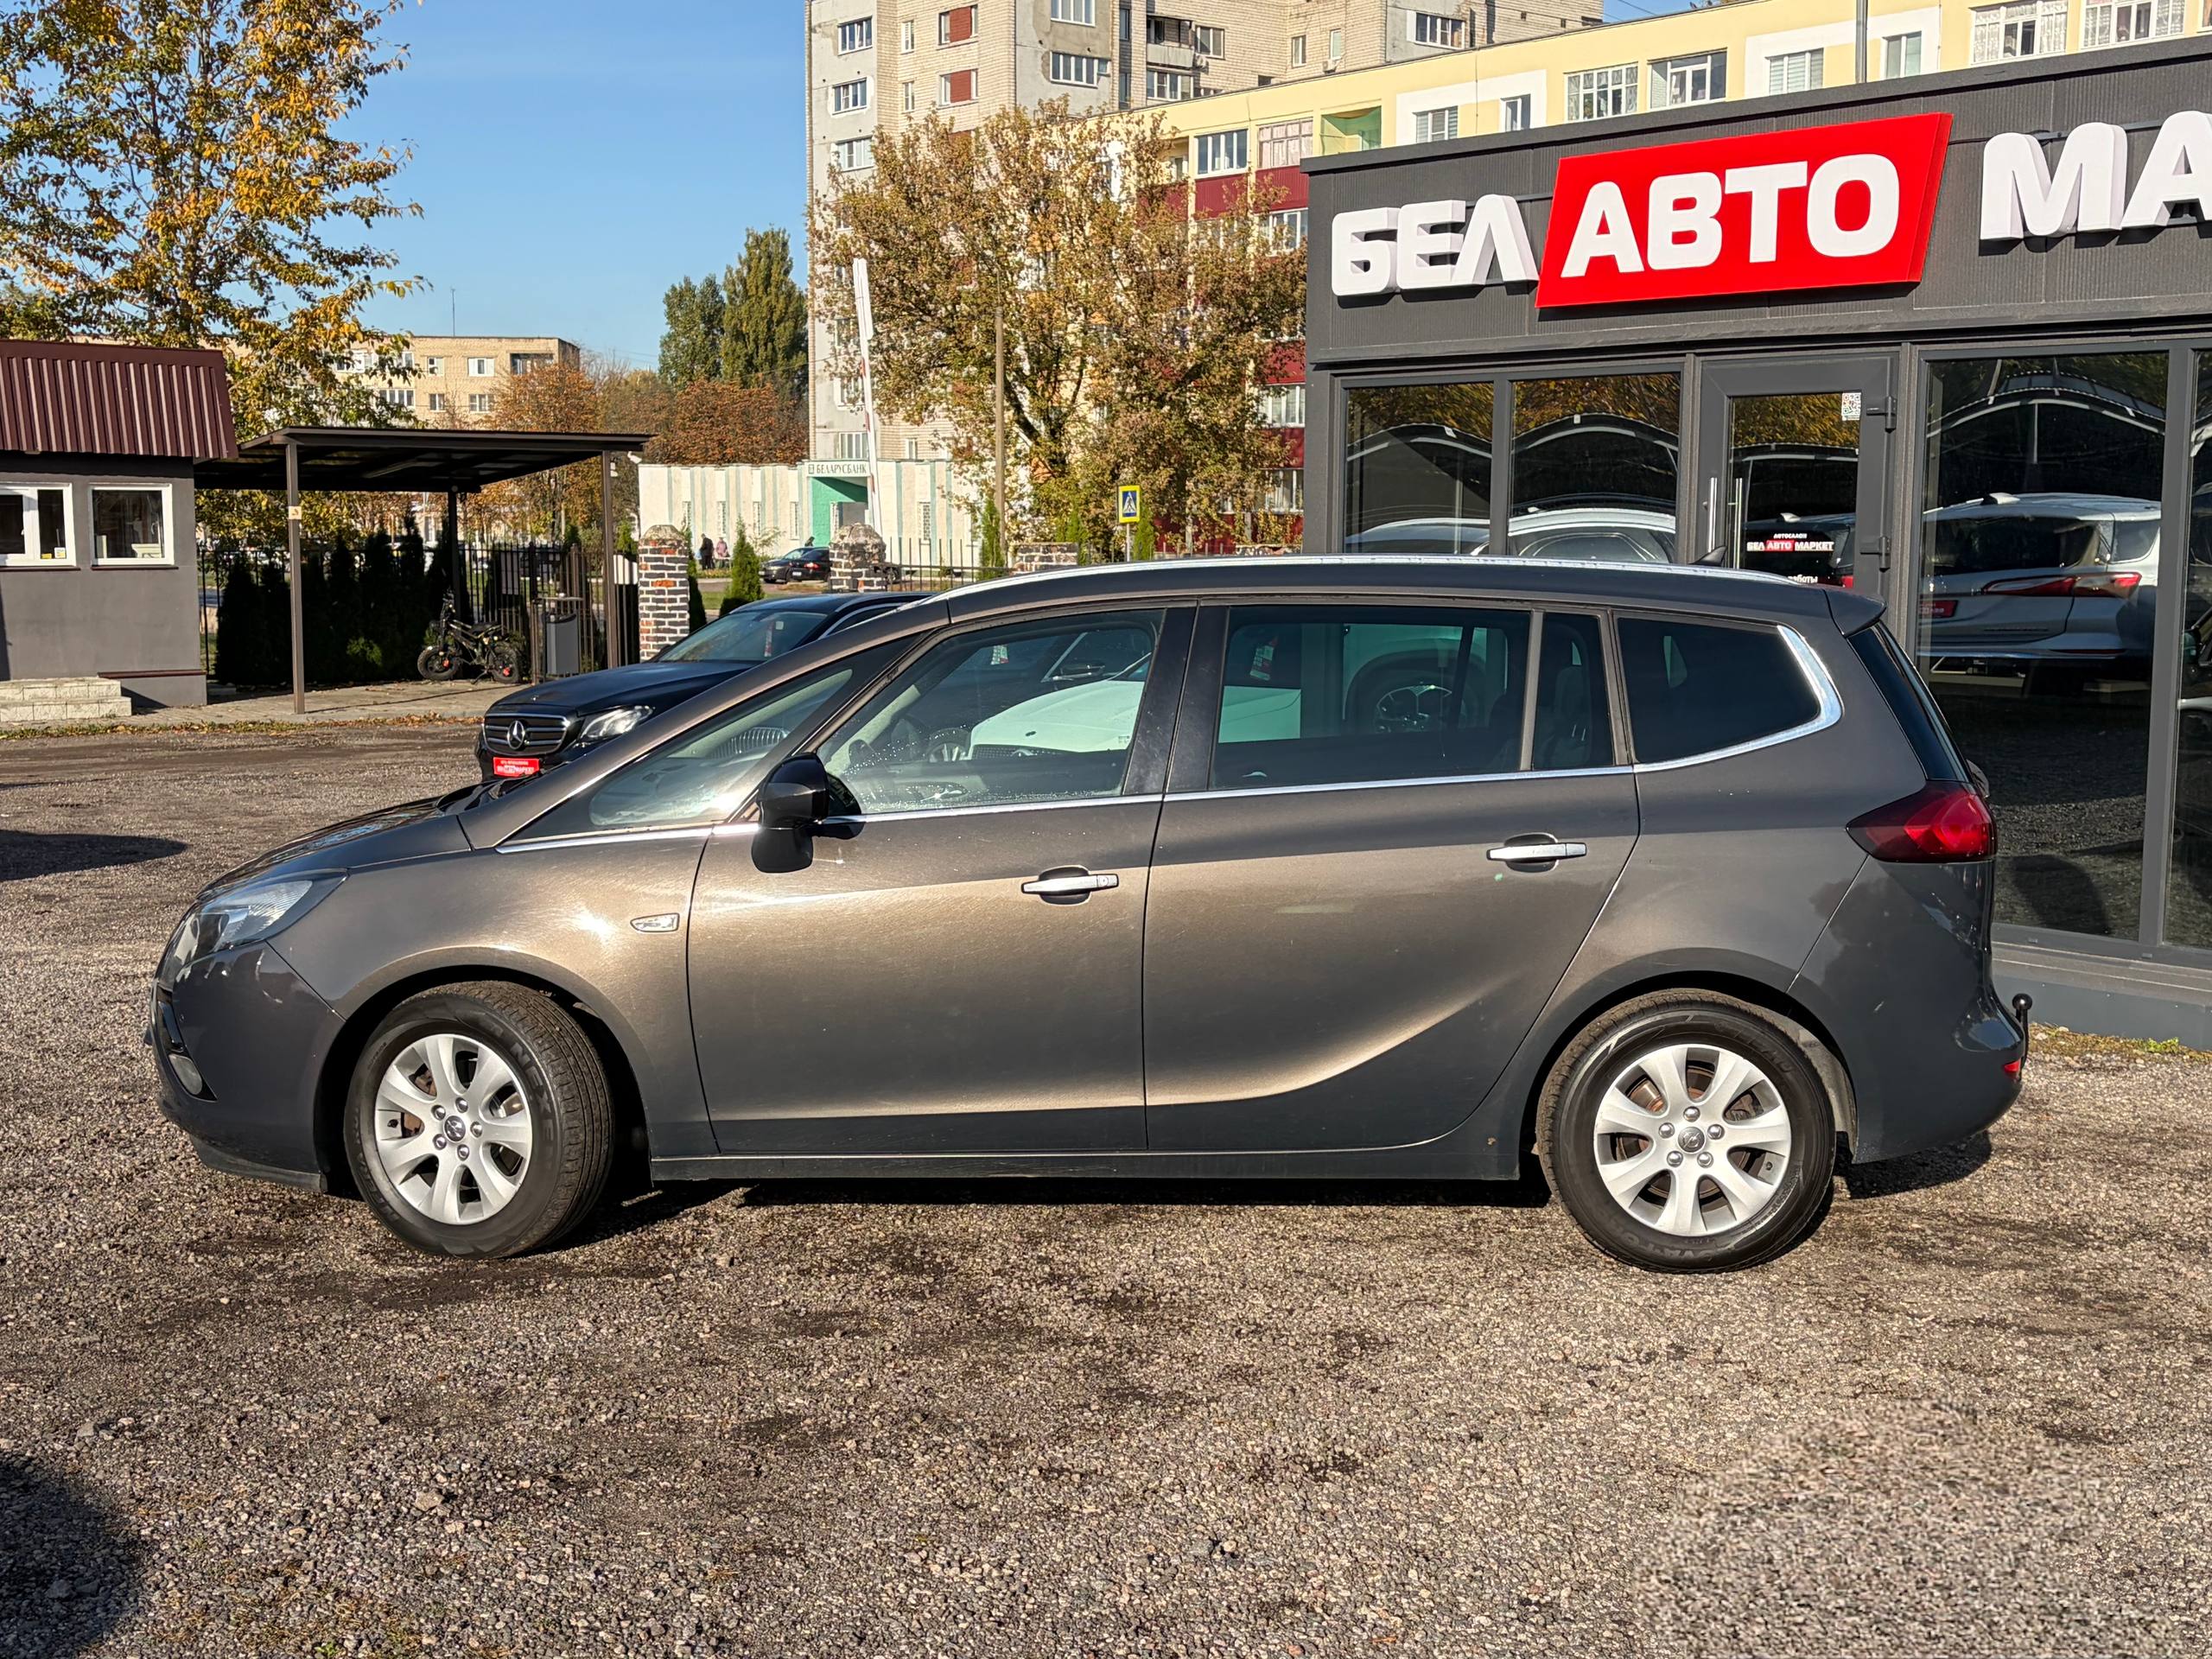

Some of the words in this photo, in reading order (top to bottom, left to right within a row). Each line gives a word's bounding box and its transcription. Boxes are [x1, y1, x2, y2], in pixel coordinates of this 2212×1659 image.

[1332, 194, 1541, 296] БЕЛ
[1560, 154, 1899, 278] АВТО
[1980, 111, 2212, 240] МА
[817, 464, 867, 474] БЕЛАРУСБАНК
[1746, 542, 1764, 551] БЕЛ
[1767, 541, 1792, 550] АВТО
[1794, 541, 1834, 551] МАРКЕТ
